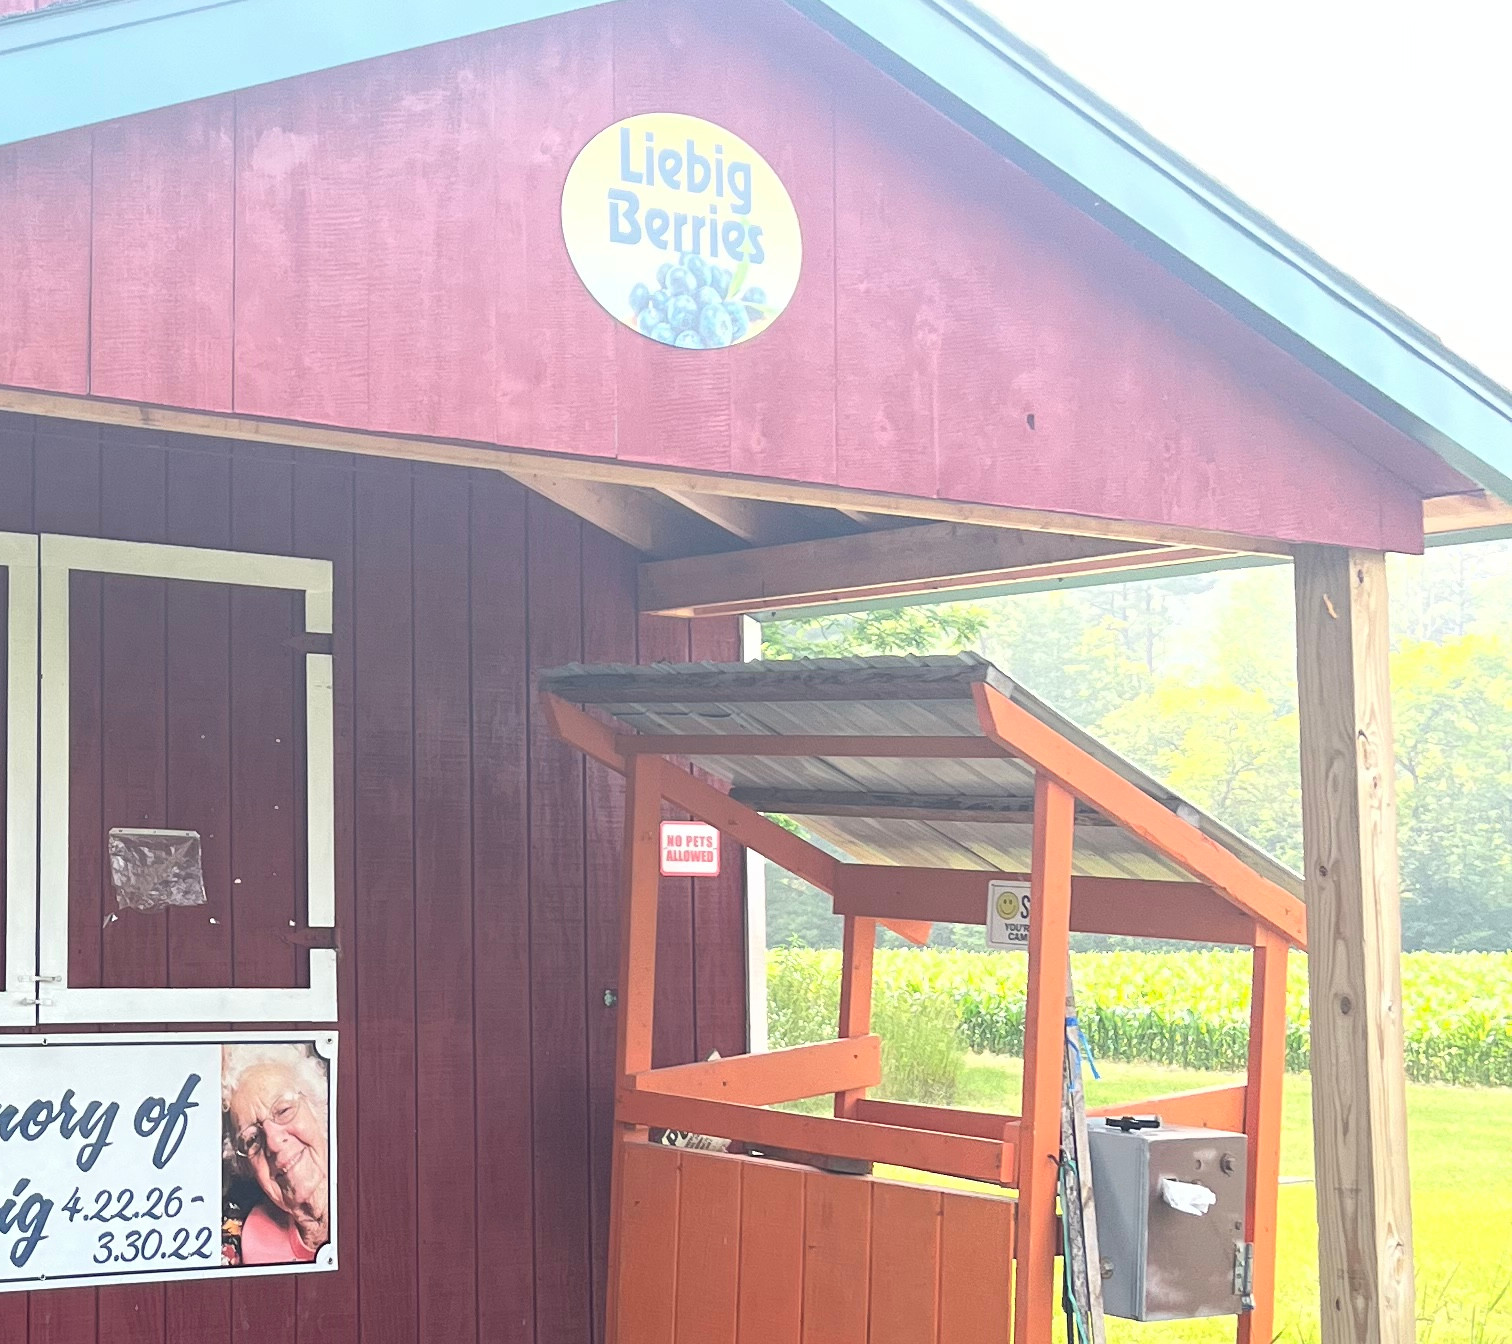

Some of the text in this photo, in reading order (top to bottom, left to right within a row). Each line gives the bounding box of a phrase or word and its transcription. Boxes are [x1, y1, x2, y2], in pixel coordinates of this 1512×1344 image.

[620, 126, 752, 215] Liebig
[607, 187, 765, 265] Berries
[666, 835, 713, 848] NO PETS
[665, 850, 714, 863] ALLOWED
[1020, 894, 1031, 919] S
[1004, 922, 1030, 932] YOU'R
[1007, 932, 1028, 941] CAM
[133, 1073, 202, 1169] of
[93, 1226, 213, 1264] 3.30.22
